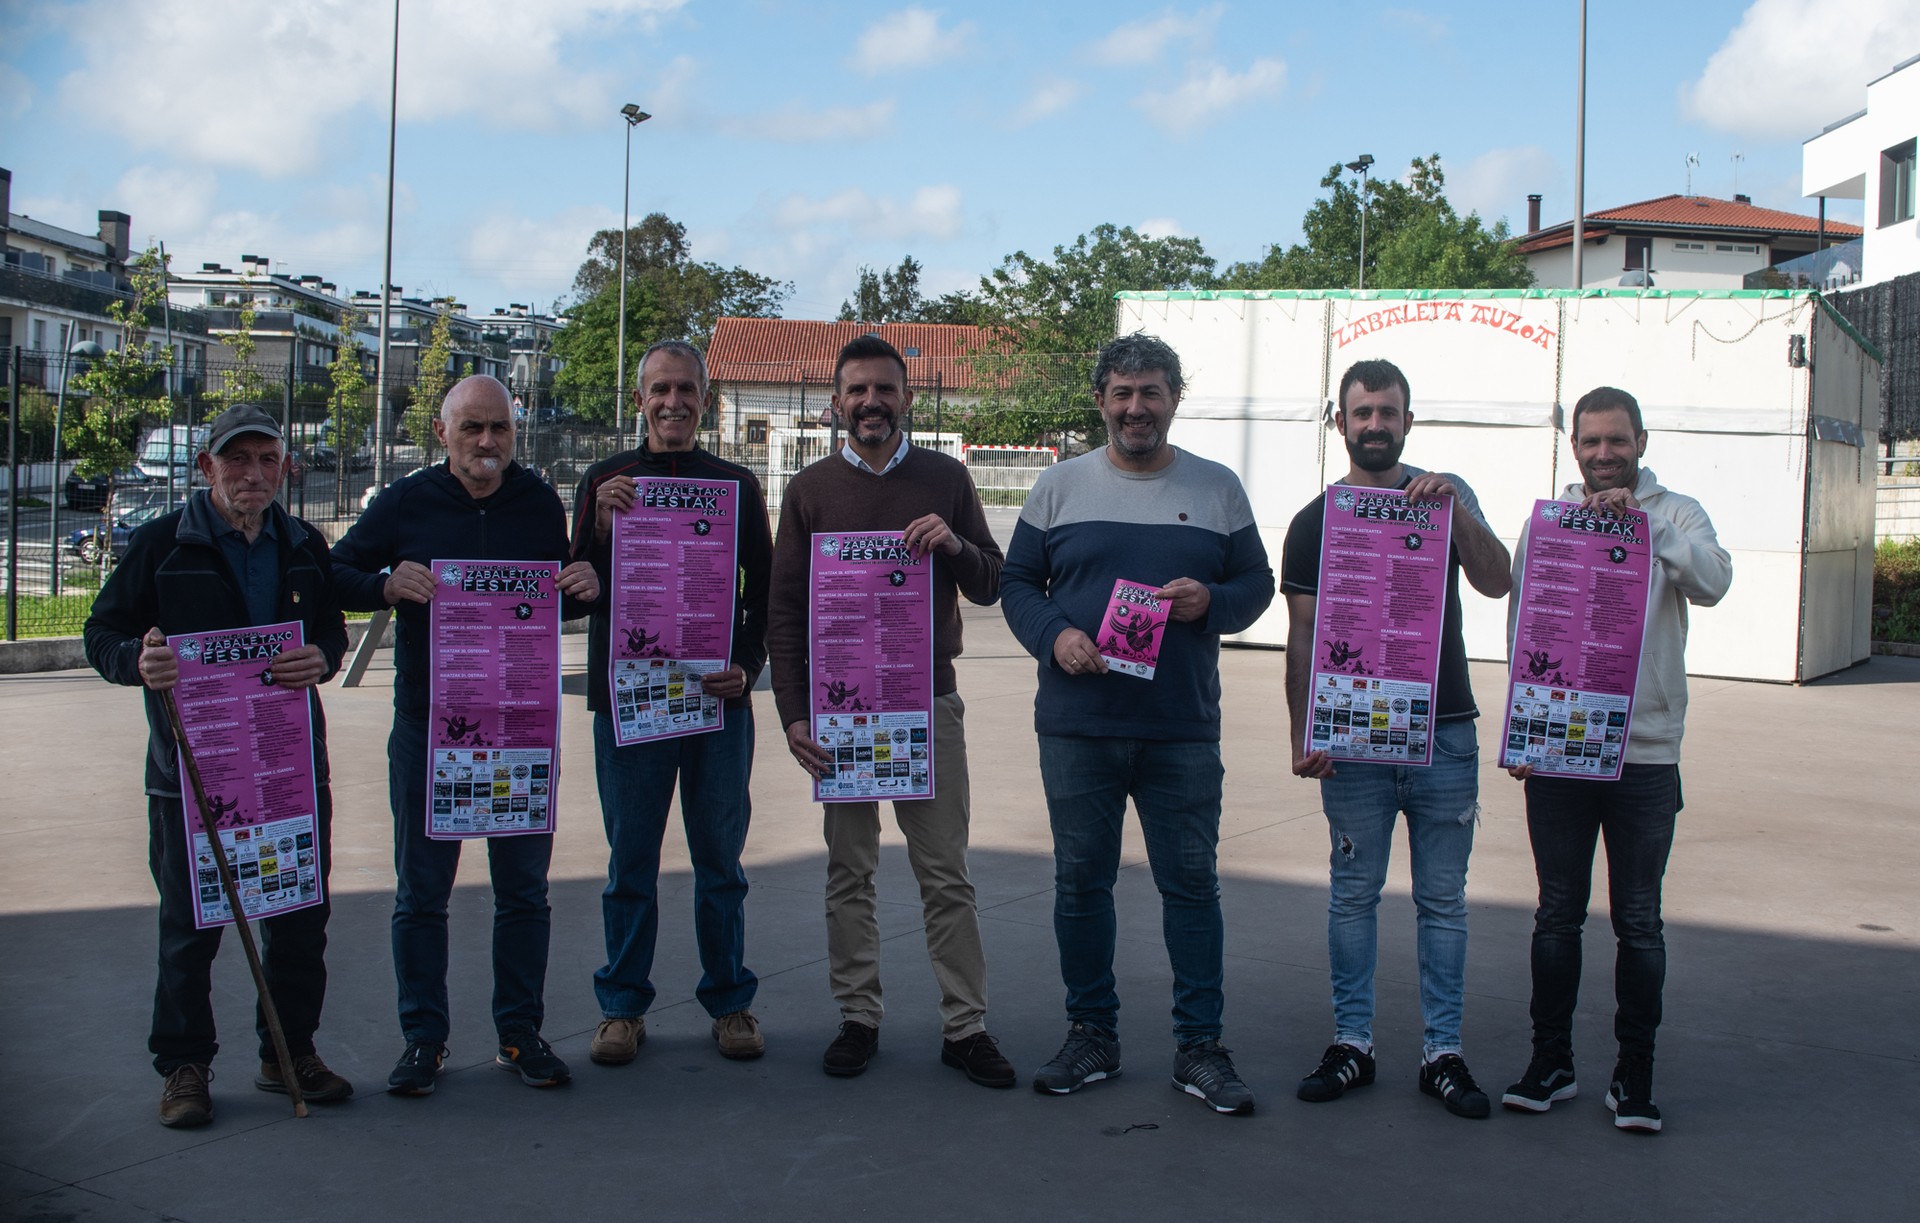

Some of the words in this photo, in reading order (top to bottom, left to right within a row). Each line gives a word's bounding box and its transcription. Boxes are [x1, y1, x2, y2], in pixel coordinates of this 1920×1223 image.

[1332, 302, 1464, 349] ZABALETA
[1470, 304, 1556, 350] AUZOA
[648, 487, 728, 496] ZABALETAKO
[644, 496, 716, 508] FESTAK
[1356, 506, 1429, 523] FESTAK
[1560, 516, 1634, 536] FESTAK
[1620, 536, 1642, 544] 2024
[840, 548, 910, 560] FESTAK
[466, 570, 551, 578] ZABALETAKO
[464, 580, 538, 592] FESTAK
[1115, 591, 1160, 607] FESTAK
[206, 631, 293, 652] ZABALETAKO
[203, 644, 282, 664] FESTAK
